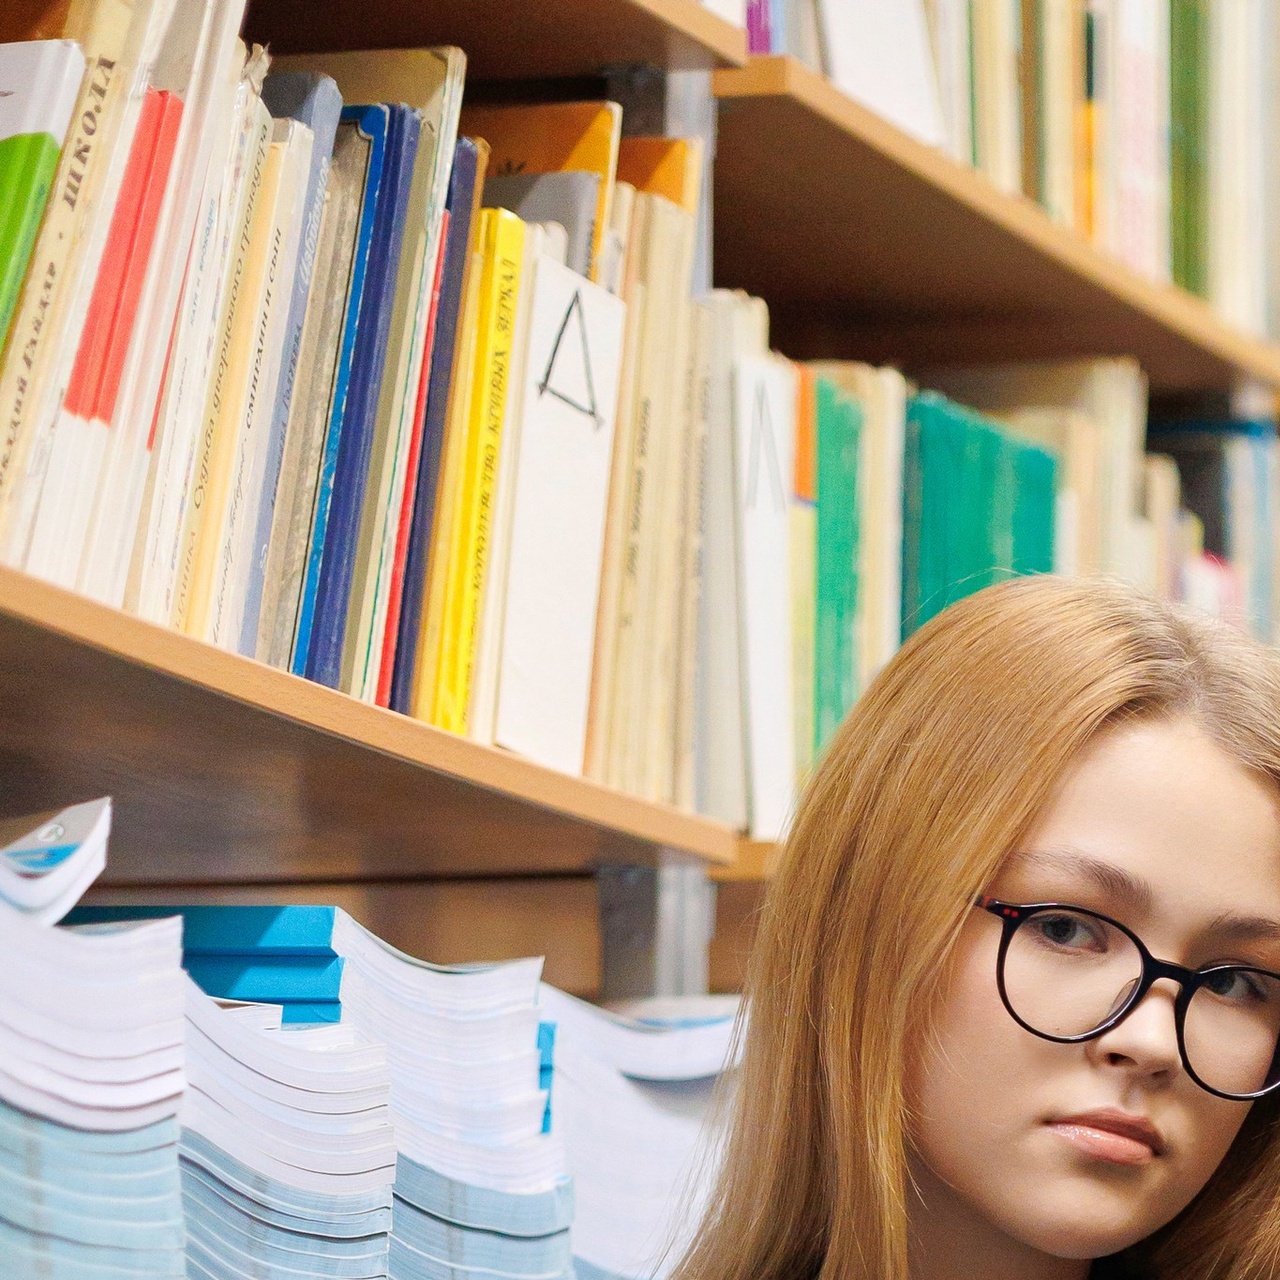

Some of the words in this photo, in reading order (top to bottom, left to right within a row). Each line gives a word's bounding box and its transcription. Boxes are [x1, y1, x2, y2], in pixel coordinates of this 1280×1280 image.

[63, 53, 116, 212] ШКОЛА
[194, 418, 215, 509] Судьба
[213, 258, 243, 415] дворцового
[240, 123, 268, 252] гренадера
[246, 311, 268, 429] СМИРДИН
[269, 228, 282, 283] СЫН
